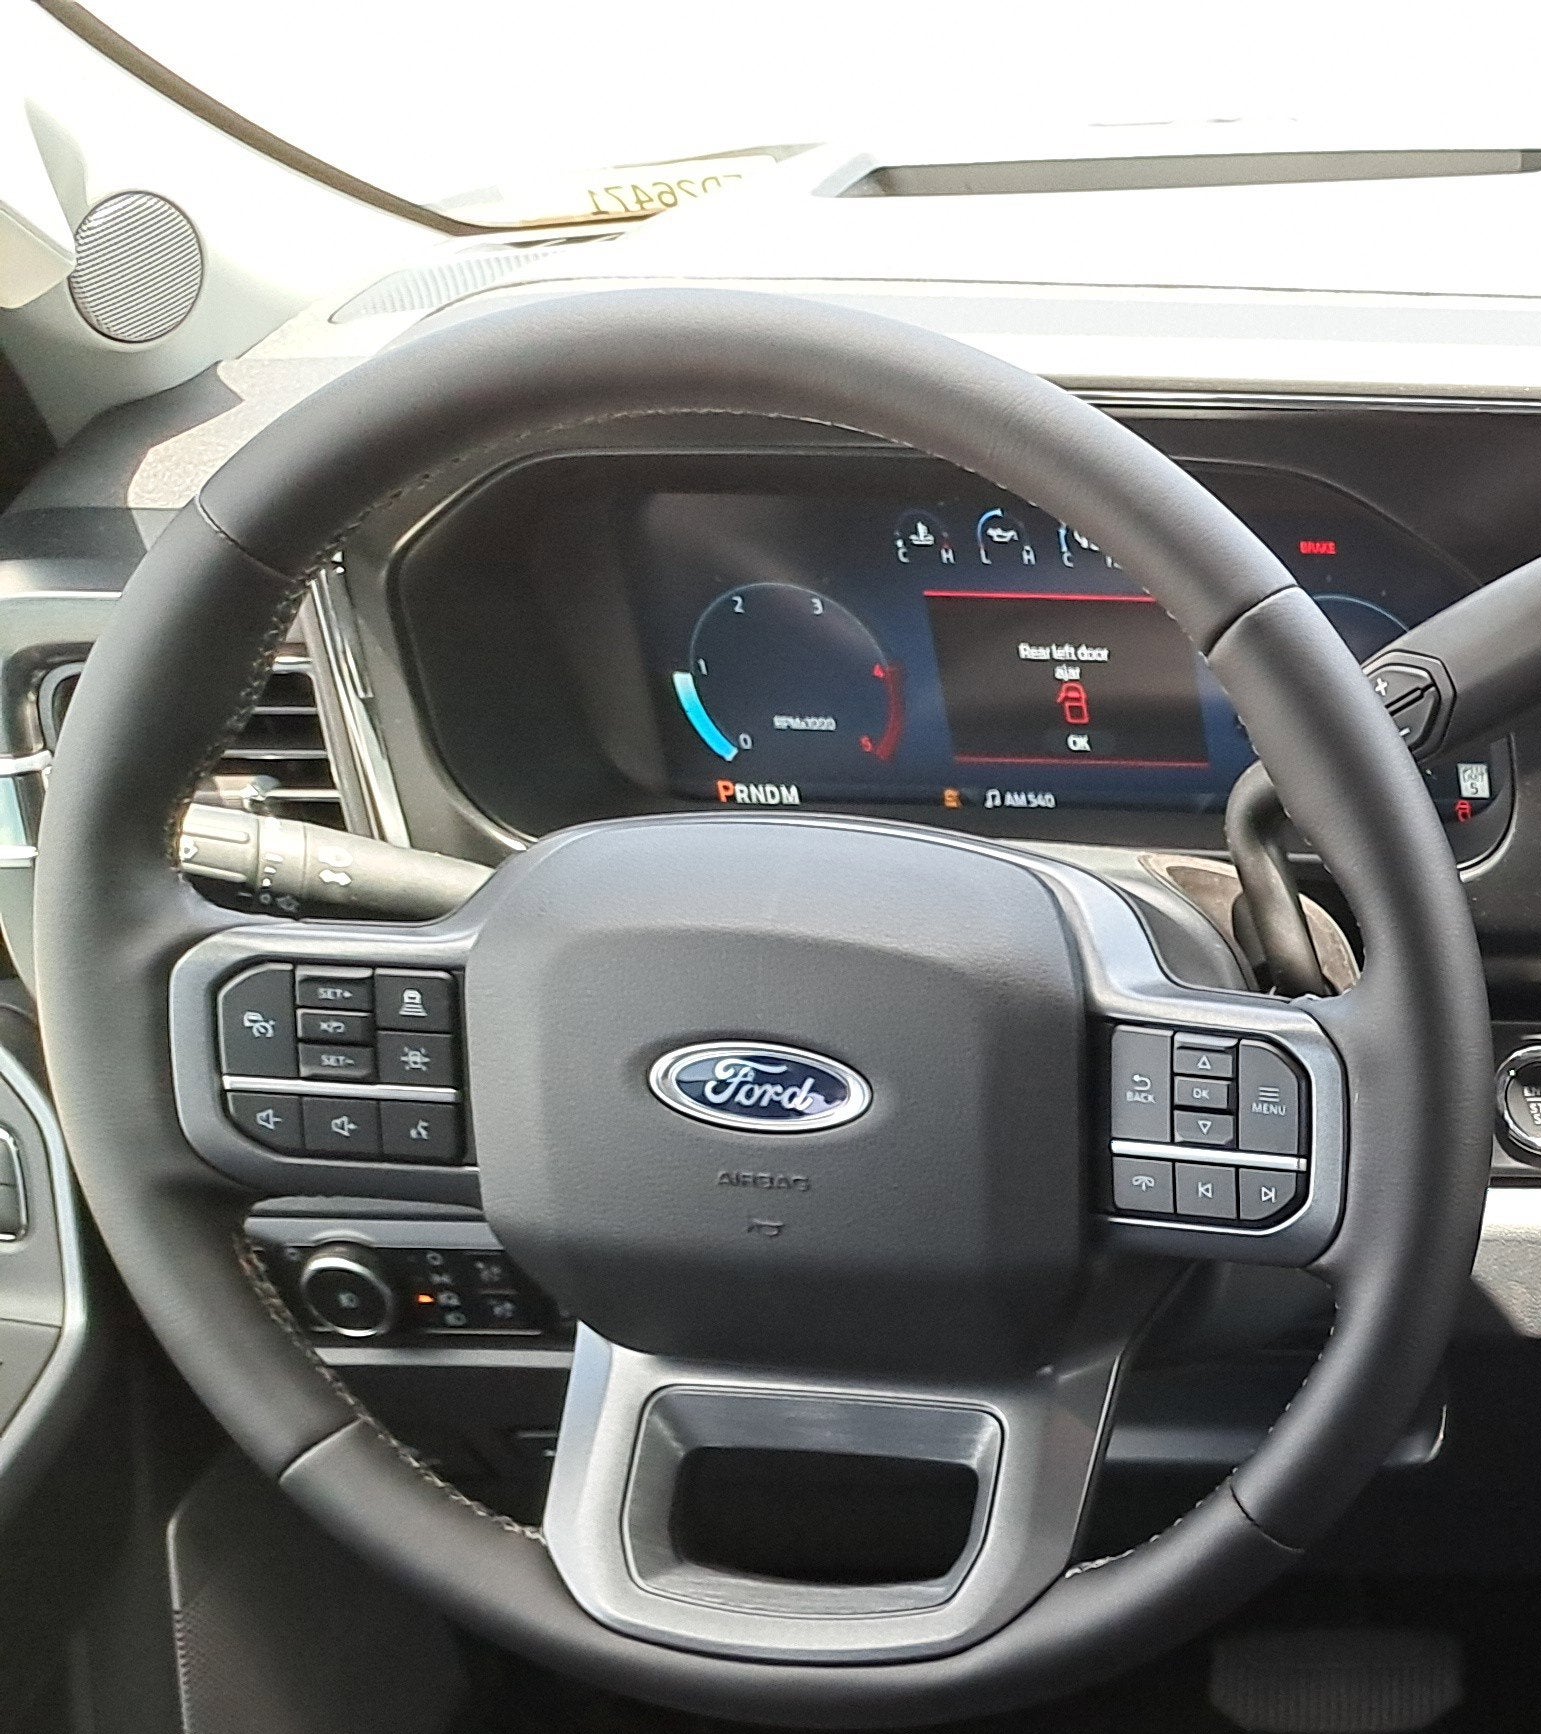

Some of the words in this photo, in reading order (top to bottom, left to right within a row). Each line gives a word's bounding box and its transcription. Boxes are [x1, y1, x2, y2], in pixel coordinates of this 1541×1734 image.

[732, 596, 744, 613] 2
[812, 598, 824, 614] 3
[1018, 642, 1050, 659] Rear
[1051, 643, 1077, 660] left
[1077, 644, 1109, 661] door
[698, 658, 708, 675] 1
[1054, 664, 1080, 681] ajar
[739, 733, 752, 750] 0
[1067, 734, 1091, 751] OK
[704, 1058, 815, 1112] Ford
[1192, 1087, 1210, 1100] OK
[1126, 1091, 1157, 1104] BACK
[1251, 1102, 1287, 1116] MENU
